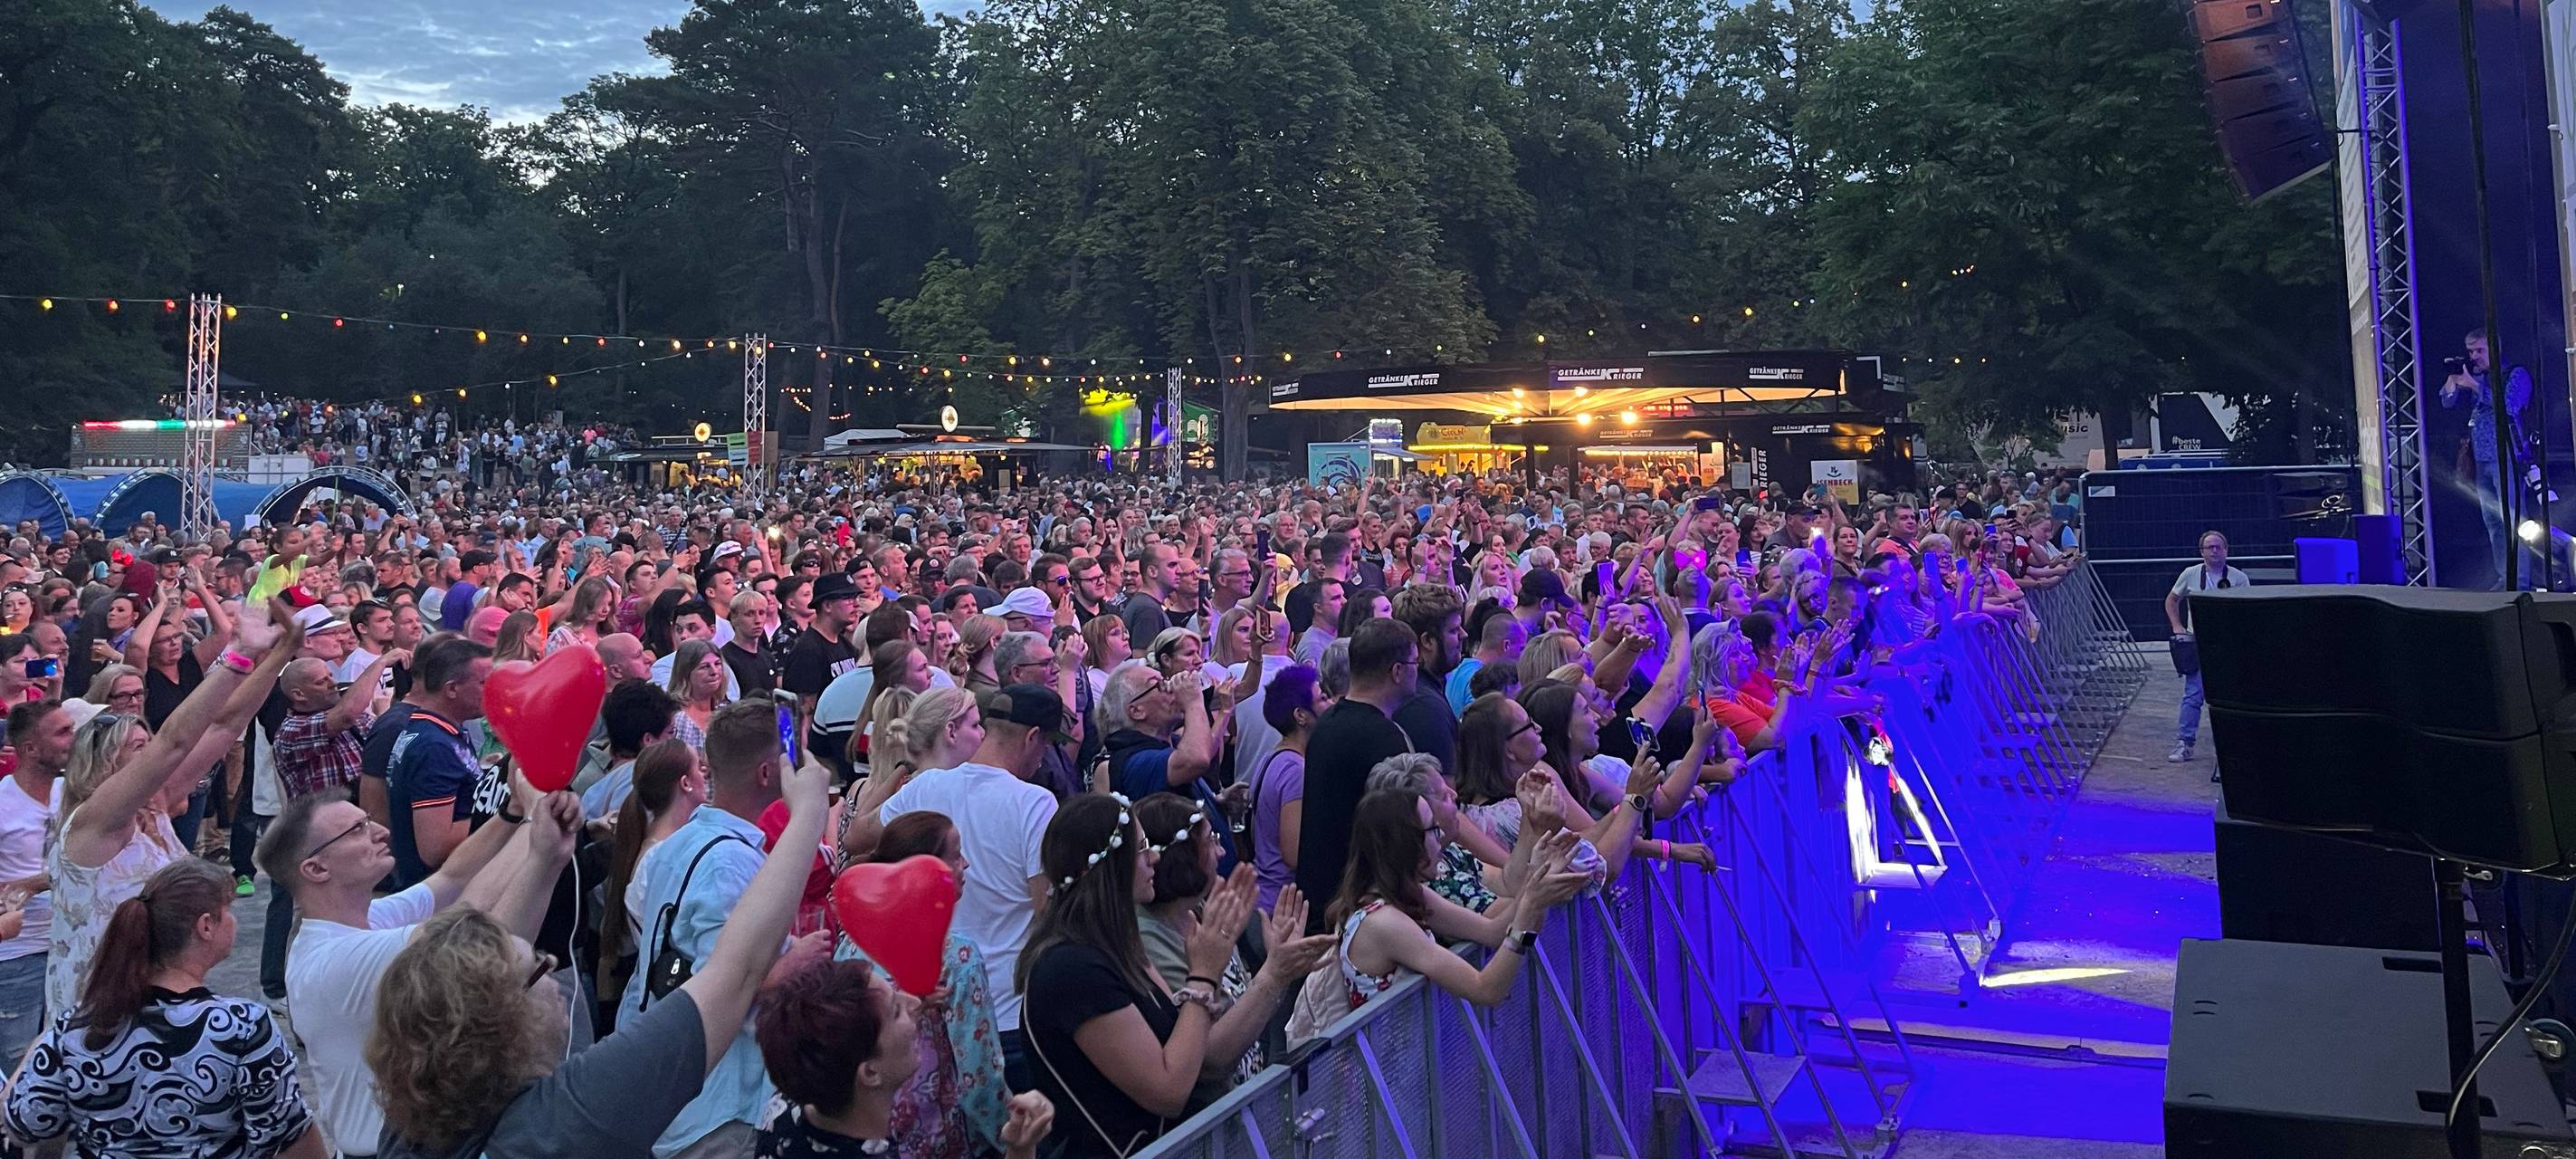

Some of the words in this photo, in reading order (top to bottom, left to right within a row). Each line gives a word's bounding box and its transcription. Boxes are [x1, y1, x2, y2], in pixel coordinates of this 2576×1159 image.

[1558, 367, 1601, 376] GETRÄNKE
[1600, 368, 1643, 379] KRIEGER
[1369, 374, 1404, 383] GETRÄNKE
[1404, 374, 1439, 386] KRIEGER
[1758, 449, 1768, 489] RIEGER
